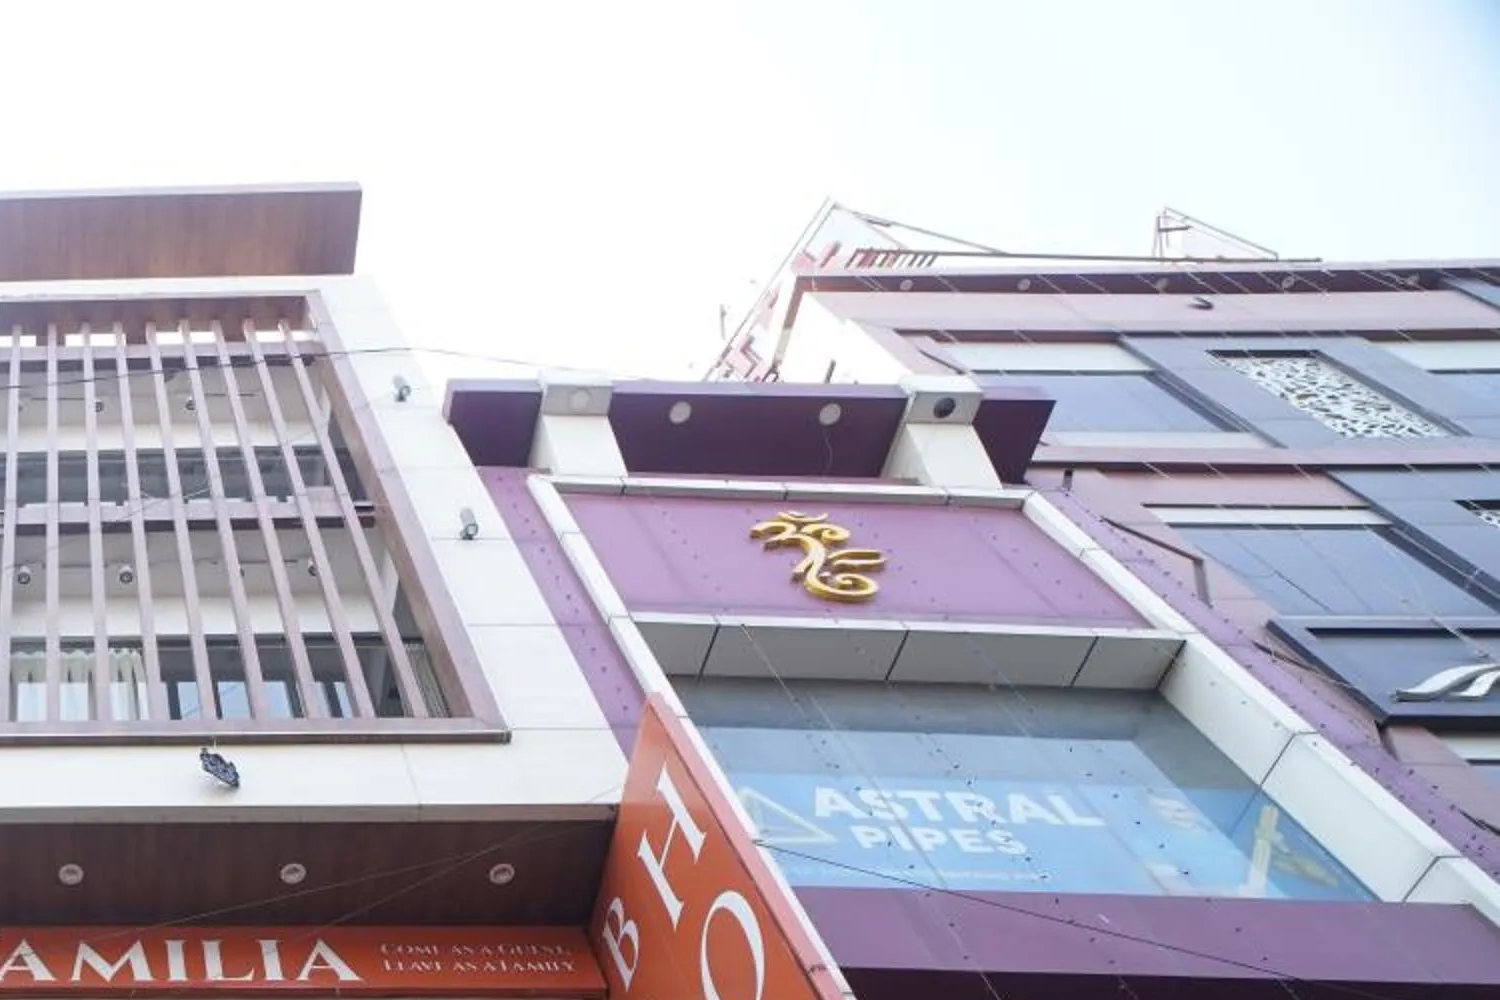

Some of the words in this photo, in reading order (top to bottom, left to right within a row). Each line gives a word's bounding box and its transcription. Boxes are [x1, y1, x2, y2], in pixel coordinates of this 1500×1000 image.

[814, 786, 1108, 827] ASTRAL
[849, 825, 1028, 855] PIPES
[380, 943, 439, 956] COME
[382, 959, 442, 972] LEAVE
[452, 960, 478, 972] AS
[499, 959, 576, 973] FAMILY
